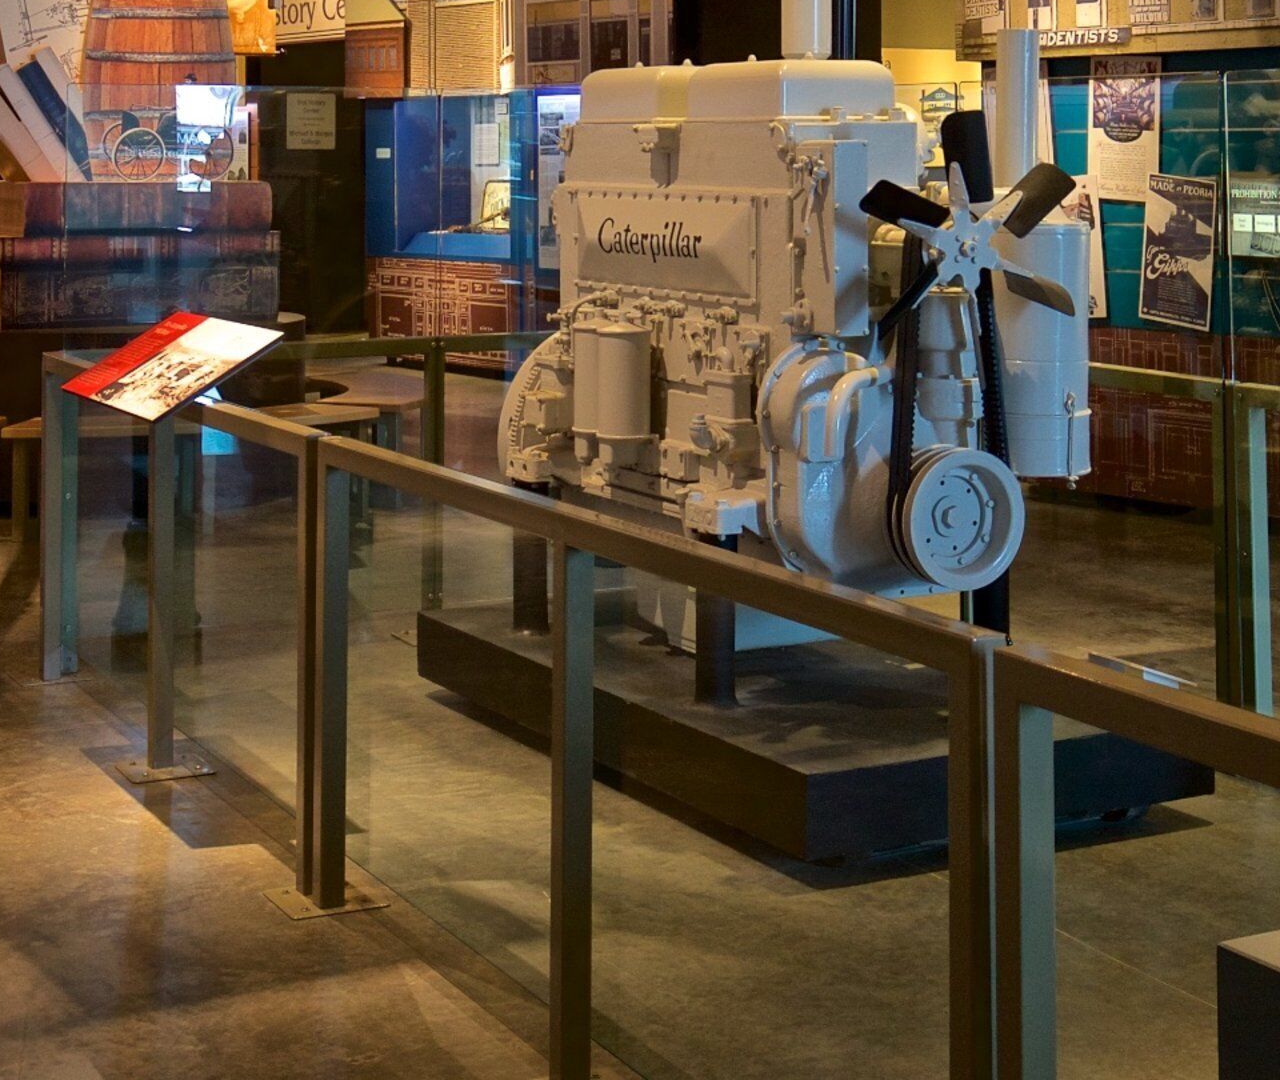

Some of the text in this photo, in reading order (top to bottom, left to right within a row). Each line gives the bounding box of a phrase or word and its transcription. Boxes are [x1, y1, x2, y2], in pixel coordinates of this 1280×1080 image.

[965, 3, 1000, 19] DENTISTS
[1150, 180, 1175, 193] MADE
[1183, 184, 1213, 198] PEORIA
[1231, 188, 1278, 199] PROHIBITION
[597, 217, 702, 263] Caterpillar
